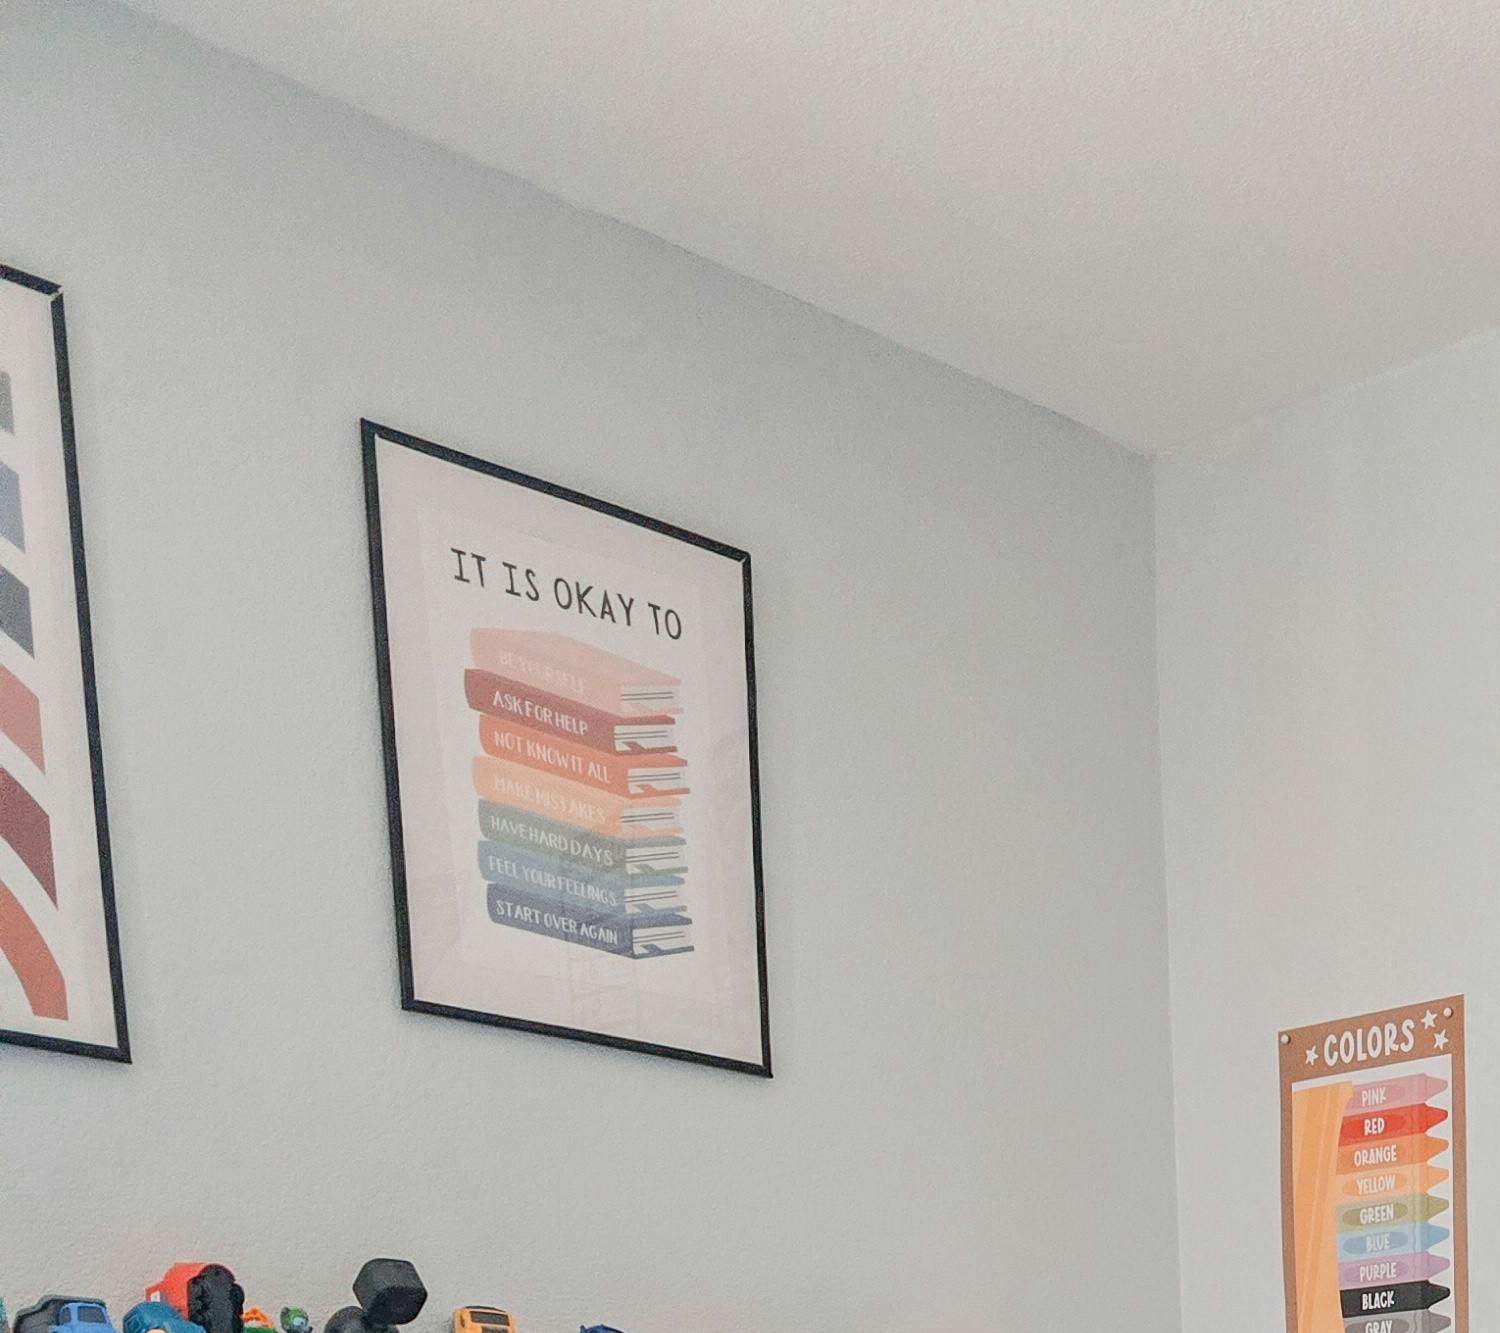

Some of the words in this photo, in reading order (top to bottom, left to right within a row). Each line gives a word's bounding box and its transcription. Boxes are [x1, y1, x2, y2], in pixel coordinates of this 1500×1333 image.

[450, 547, 487, 588] IT
[502, 561, 540, 602] IS
[553, 577, 635, 627] OKAY
[648, 602, 682, 640] TO
[493, 689, 524, 716] ASK
[523, 702, 554, 725] FOR
[555, 712, 589, 737] HELP
[493, 730, 522, 754] NOT
[526, 739, 570, 769] KNOW
[569, 753, 584, 773] IT
[587, 763, 611, 784] ALL
[490, 815, 528, 840] HAVE
[528, 826, 569, 852] HARD
[570, 840, 614, 867] DAYS
[488, 854, 519, 883] FEEL
[520, 866, 557, 889] YOUR
[557, 879, 617, 909] FEELINGS
[496, 899, 541, 925] START
[543, 912, 578, 935] OVER
[579, 921, 619, 946] AGAIN
[1323, 1016, 1416, 1067] COLORS
[1361, 1086, 1388, 1107] PINK
[1363, 1117, 1386, 1137] RED
[1353, 1144, 1398, 1168] ORANGE
[1356, 1173, 1397, 1196] YELLOW
[1359, 1204, 1395, 1226] GREEN
[1365, 1233, 1391, 1253] BLUE
[1359, 1262, 1398, 1284] PURPLE
[1361, 1290, 1396, 1312] BLACK
